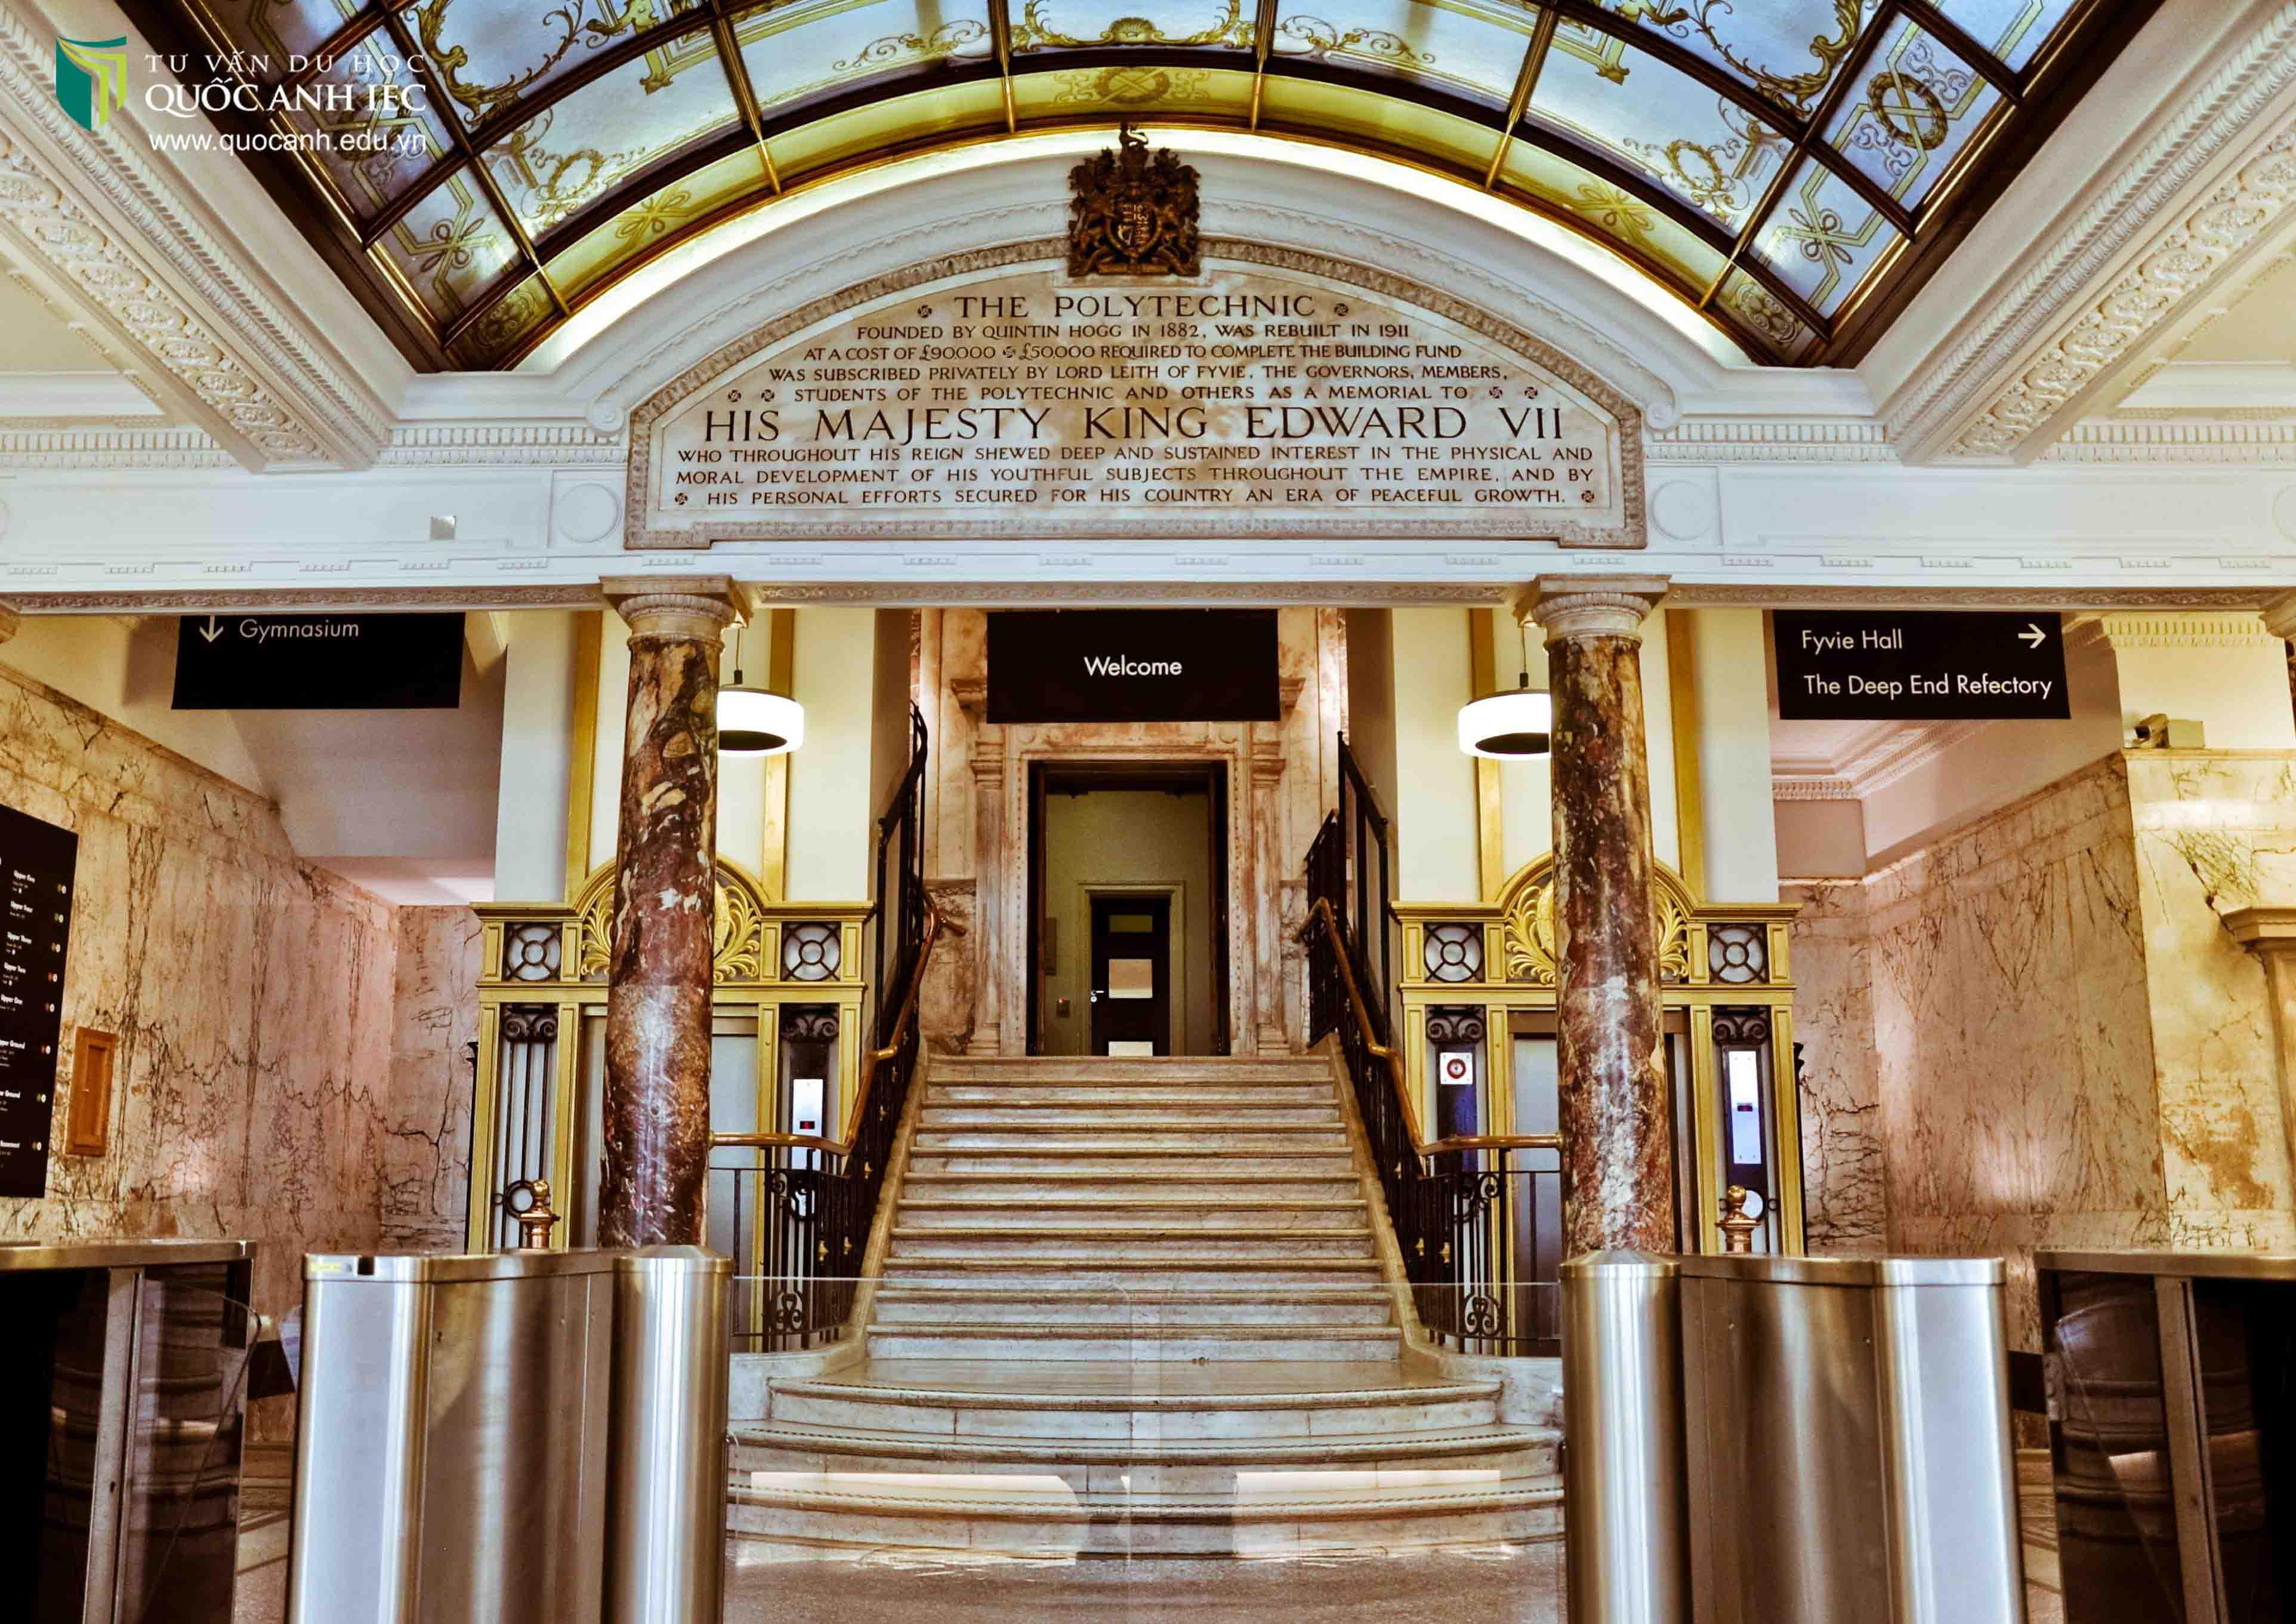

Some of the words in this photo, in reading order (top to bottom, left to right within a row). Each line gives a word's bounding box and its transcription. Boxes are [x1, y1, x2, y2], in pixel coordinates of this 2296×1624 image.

[953, 296, 1029, 318] THE
[1054, 295, 1315, 318] POLYTECHNIC
[857, 326, 943, 340] FOUNDED
[953, 325, 976, 339] BY
[982, 325, 1059, 340] QUINTIN
[1069, 324, 1121, 338] HOGG
[1132, 324, 1150, 337] IN
[1161, 323, 1206, 340] 1882,
[1215, 324, 1255, 338] WAS
[1264, 324, 1341, 337] REBUILT
[1351, 324, 1370, 337] IN
[1379, 324, 1409, 338] 1911
[803, 347, 826, 361] AT
[828, 348, 842, 360] A
[845, 347, 890, 360] COST
[893, 347, 917, 360] OF
[1100, 345, 1181, 360] REQUIRED
[1183, 345, 1206, 359] TO
[1210, 344, 1296, 359] COMPLETE
[1298, 344, 1331, 359] THE
[1334, 344, 1411, 359] BUILDING
[1415, 344, 1462, 359] FUND
[769, 368, 806, 382] WAS
[814, 367, 921, 381] SUBSCRIBED
[929, 366, 1018, 380] PRIVATELY
[1026, 366, 1048, 380] BY
[1056, 366, 1103, 380] LORD
[1110, 365, 1158, 379] LEITH
[1168, 365, 1190, 378] OF
[1197, 365, 1253, 380] FYVIE,
[1261, 365, 1297, 378] THE
[1305, 365, 1414, 380] GOVERNORS,
[1421, 365, 1508, 381] MEMBERS,
[794, 388, 887, 402] STUDENTS
[897, 387, 921, 401] OF
[931, 387, 967, 401] THE
[981, 386, 1113, 400] POLYTECHNIC
[1125, 386, 1168, 400] AND
[1181, 386, 1254, 400] OTHERS
[1269, 386, 1292, 399] AS
[1304, 386, 1318, 399] A
[1328, 386, 1433, 400] MEMORIAL
[1440, 386, 1468, 400] TO
[705, 410, 779, 442] HIS
[814, 407, 1051, 446] MAJESTY
[1084, 406, 1208, 439] KING
[1246, 406, 1467, 439] EDWARD
[1499, 407, 1563, 439] VII
[677, 449, 722, 463] WHO
[730, 448, 860, 463] THROUGHOUT
[870, 448, 901, 462] HIS
[911, 448, 964, 461] REIGN
[975, 447, 1051, 461] SHEWED
[1061, 446, 1106, 460] DEEP
[1114, 446, 1153, 460] AND
[1164, 446, 1260, 460] SUSTAINED
[1272, 446, 1360, 460] INTEREST
[1371, 446, 1390, 460] IN
[1401, 446, 1440, 460] THE
[1451, 446, 1541, 460] PHYSICAL
[1552, 447, 1593, 461] AND
[675, 469, 745, 485] MORAL
[757, 469, 900, 484] DEVELOPMENT
[911, 469, 935, 482] OF
[947, 469, 978, 482] HIS
[990, 467, 1094, 482] YOUTHFUL
[1106, 467, 1196, 483] SUBJECTS
[1207, 467, 1348, 481] THROUGHOUT
[1360, 467, 1404, 481] THE
[1511, 467, 1555, 482] AND
[1568, 468, 1593, 482] BY
[708, 492, 738, 506] HIS
[752, 491, 849, 505] PERSONAL
[862, 489, 941, 504] EFFORTS
[955, 489, 1038, 503] SECURED
[1051, 489, 1086, 503] FOR
[1100, 488, 1130, 502] HIS
[1144, 488, 1232, 502] COUNTRY
[1245, 488, 1273, 502] AN
[1286, 488, 1323, 502] ERA
[1335, 488, 1360, 502] OF
[1371, 488, 1462, 502] PEACEFUL
[1474, 489, 1565, 503] GROWTH.
[240, 619, 359, 643] Gymnasium
[1802, 630, 1854, 655] Fyvie
[1862, 628, 1902, 649] Hall
[1084, 655, 1182, 676] Welcome
[1804, 674, 1841, 695] The
[1849, 676, 1902, 701] Deep
[1911, 673, 1949, 694] End
[1957, 673, 2052, 699] Refectory
